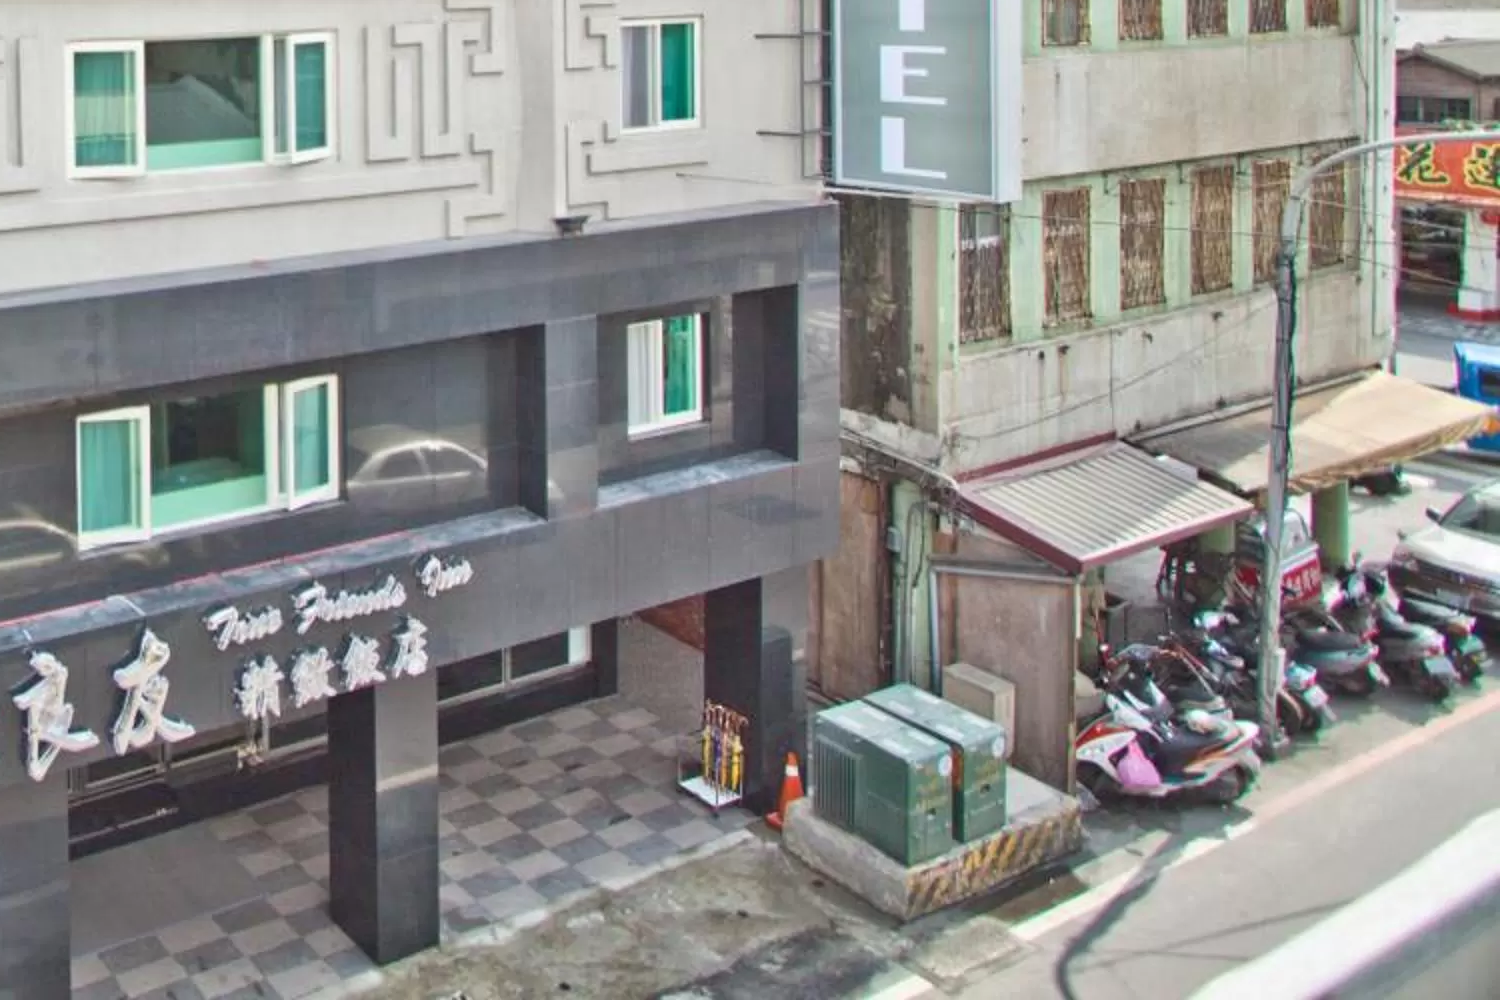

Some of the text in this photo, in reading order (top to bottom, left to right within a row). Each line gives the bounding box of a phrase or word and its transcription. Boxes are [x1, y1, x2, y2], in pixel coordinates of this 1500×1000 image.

[204, 555, 474, 650] True Friends Inn
[13, 627, 197, 782] 良友
